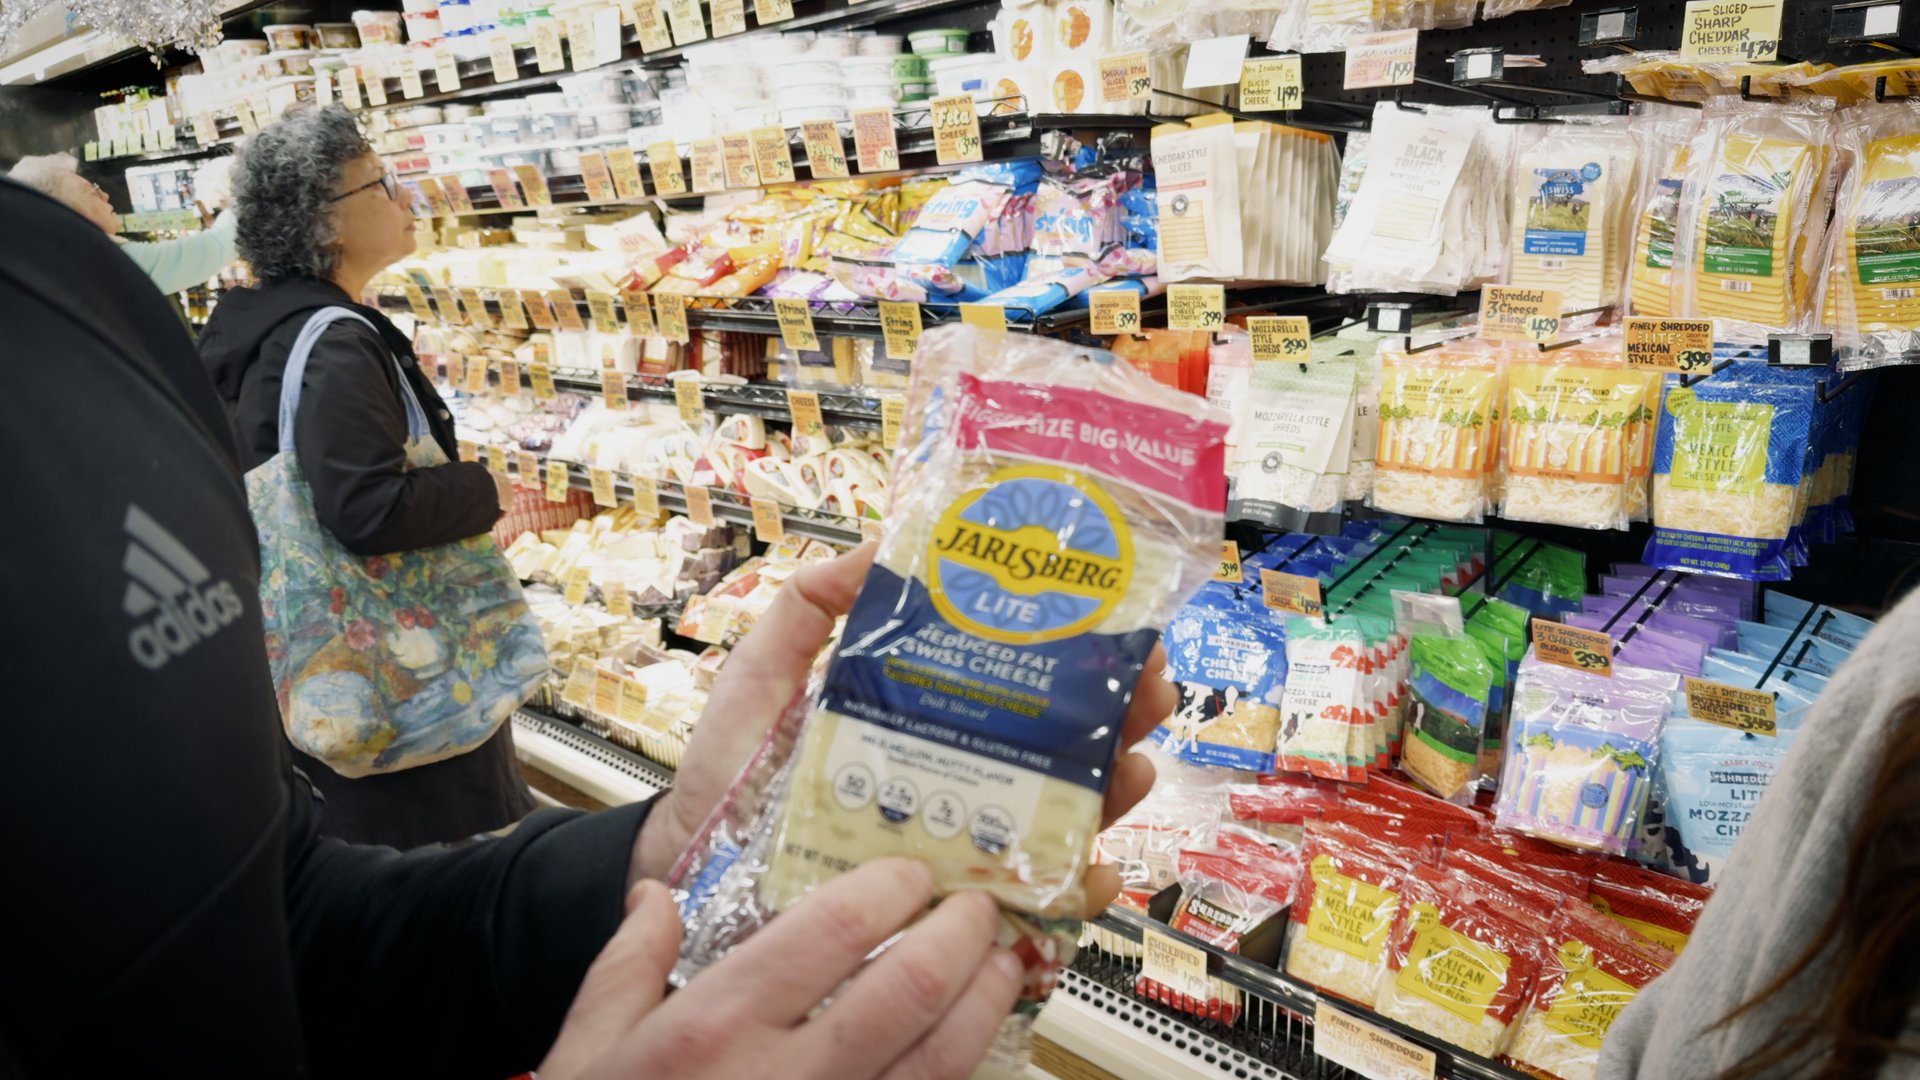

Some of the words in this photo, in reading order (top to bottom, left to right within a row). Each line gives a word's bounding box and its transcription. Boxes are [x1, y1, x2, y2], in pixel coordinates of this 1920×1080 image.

[1712, 3, 1748, 16] SLICED
[1694, 15, 1742, 31] SHARP
[1689, 28, 1750, 45] CHEDDAR
[1698, 46, 1734, 56] CHEESE
[1244, 97, 1269, 105] CHEESE
[935, 105, 971, 129] Feta
[940, 129, 968, 139] CHEESE
[1186, 147, 1208, 159] STYLE
[1404, 144, 1446, 162] BLACK
[1169, 161, 1192, 174] SLICES
[1549, 186, 1574, 194] SWISS
[924, 195, 979, 219] string
[1489, 288, 1545, 303] Shredded
[778, 302, 806, 319] String
[1170, 301, 1207, 309] PARMESAN
[1485, 300, 1499, 319] 3
[1499, 302, 1539, 315] Cheese
[782, 317, 806, 327] cheese
[885, 316, 914, 331] String
[1499, 314, 1526, 325] Blend
[1629, 321, 1658, 332] FINELY
[1660, 321, 1710, 332] SHREDDED
[887, 328, 911, 336] cheese
[1251, 325, 1300, 333] MOZZARELLA
[1252, 334, 1274, 344] STYLE
[1644, 332, 1675, 345] LITE
[1253, 344, 1281, 354] SHREDS
[1627, 342, 1671, 354] MEXICAN
[1628, 353, 1655, 364] STYLE
[790, 396, 816, 407] CHEESE
[1254, 411, 1305, 424] MOZZARELLA
[1305, 415, 1331, 428] STYLE
[1271, 422, 1302, 434] SHREDS
[1025, 412, 1075, 439] SIZE
[1079, 423, 1119, 450] BIG
[1124, 431, 1196, 468] VALUE
[1697, 458, 1738, 473] STYLE
[935, 526, 1123, 592] JARLSBERG
[974, 590, 1041, 625] LITE
[129, 579, 244, 669] adidas
[1535, 623, 1554, 634] LITE
[1557, 627, 1609, 646] SHREDDED
[1536, 632, 1546, 642] 3
[1547, 634, 1590, 651] CHEESE
[914, 625, 1017, 663] REDUCED
[1017, 650, 1060, 674] FAT
[1540, 642, 1570, 655] BLEND
[902, 636, 966, 669] SWISS
[967, 656, 1055, 693] CHEESE
[1720, 687, 1772, 706] SHREDDED
[1690, 694, 1767, 717] MOZZARELLA
[1691, 702, 1732, 718] CHEESE
[842, 701, 906, 728] NATURALLY
[906, 718, 959, 743] LACTOSE
[971, 736, 1020, 760] GLUTEN
[1020, 748, 1052, 769] FREE
[1325, 896, 1377, 924] MEXICAN
[1330, 912, 1364, 935] STYLE
[1147, 936, 1200, 967] SHREDDED
[1147, 949, 1176, 967] SWISS
[1431, 966, 1468, 993] STYLE
[1445, 987, 1472, 1005] BLEND
[1321, 1020, 1384, 1057] MEXICAN
[1330, 1015, 1362, 1034] FINELY
[1368, 1032, 1425, 1062] SHREDDED
